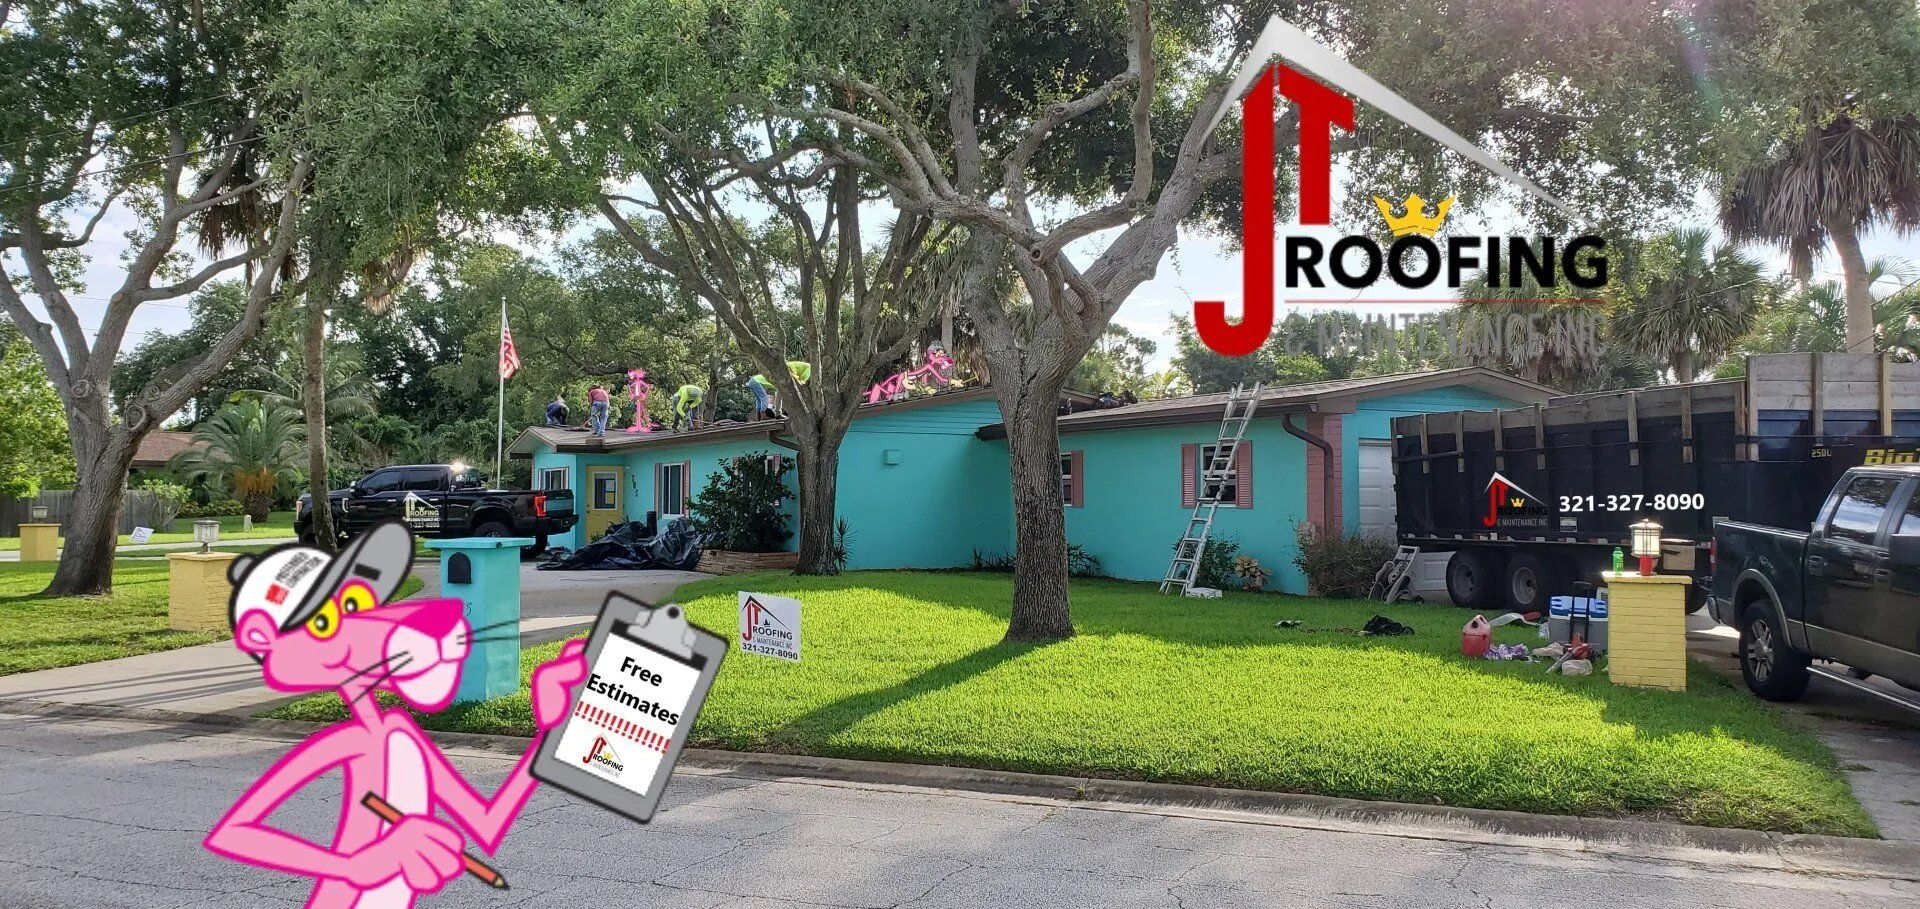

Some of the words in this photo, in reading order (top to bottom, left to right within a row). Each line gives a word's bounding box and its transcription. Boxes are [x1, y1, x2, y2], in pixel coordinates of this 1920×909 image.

[1497, 506, 1548, 515] ROOFING
[1559, 493, 1705, 512] 321-327-8090
[1503, 518, 1537, 526] MAINTENANCE
[1539, 518, 1548, 526] INC
[752, 625, 793, 641] ROOFING
[742, 643, 798, 660] 321-327-8090
